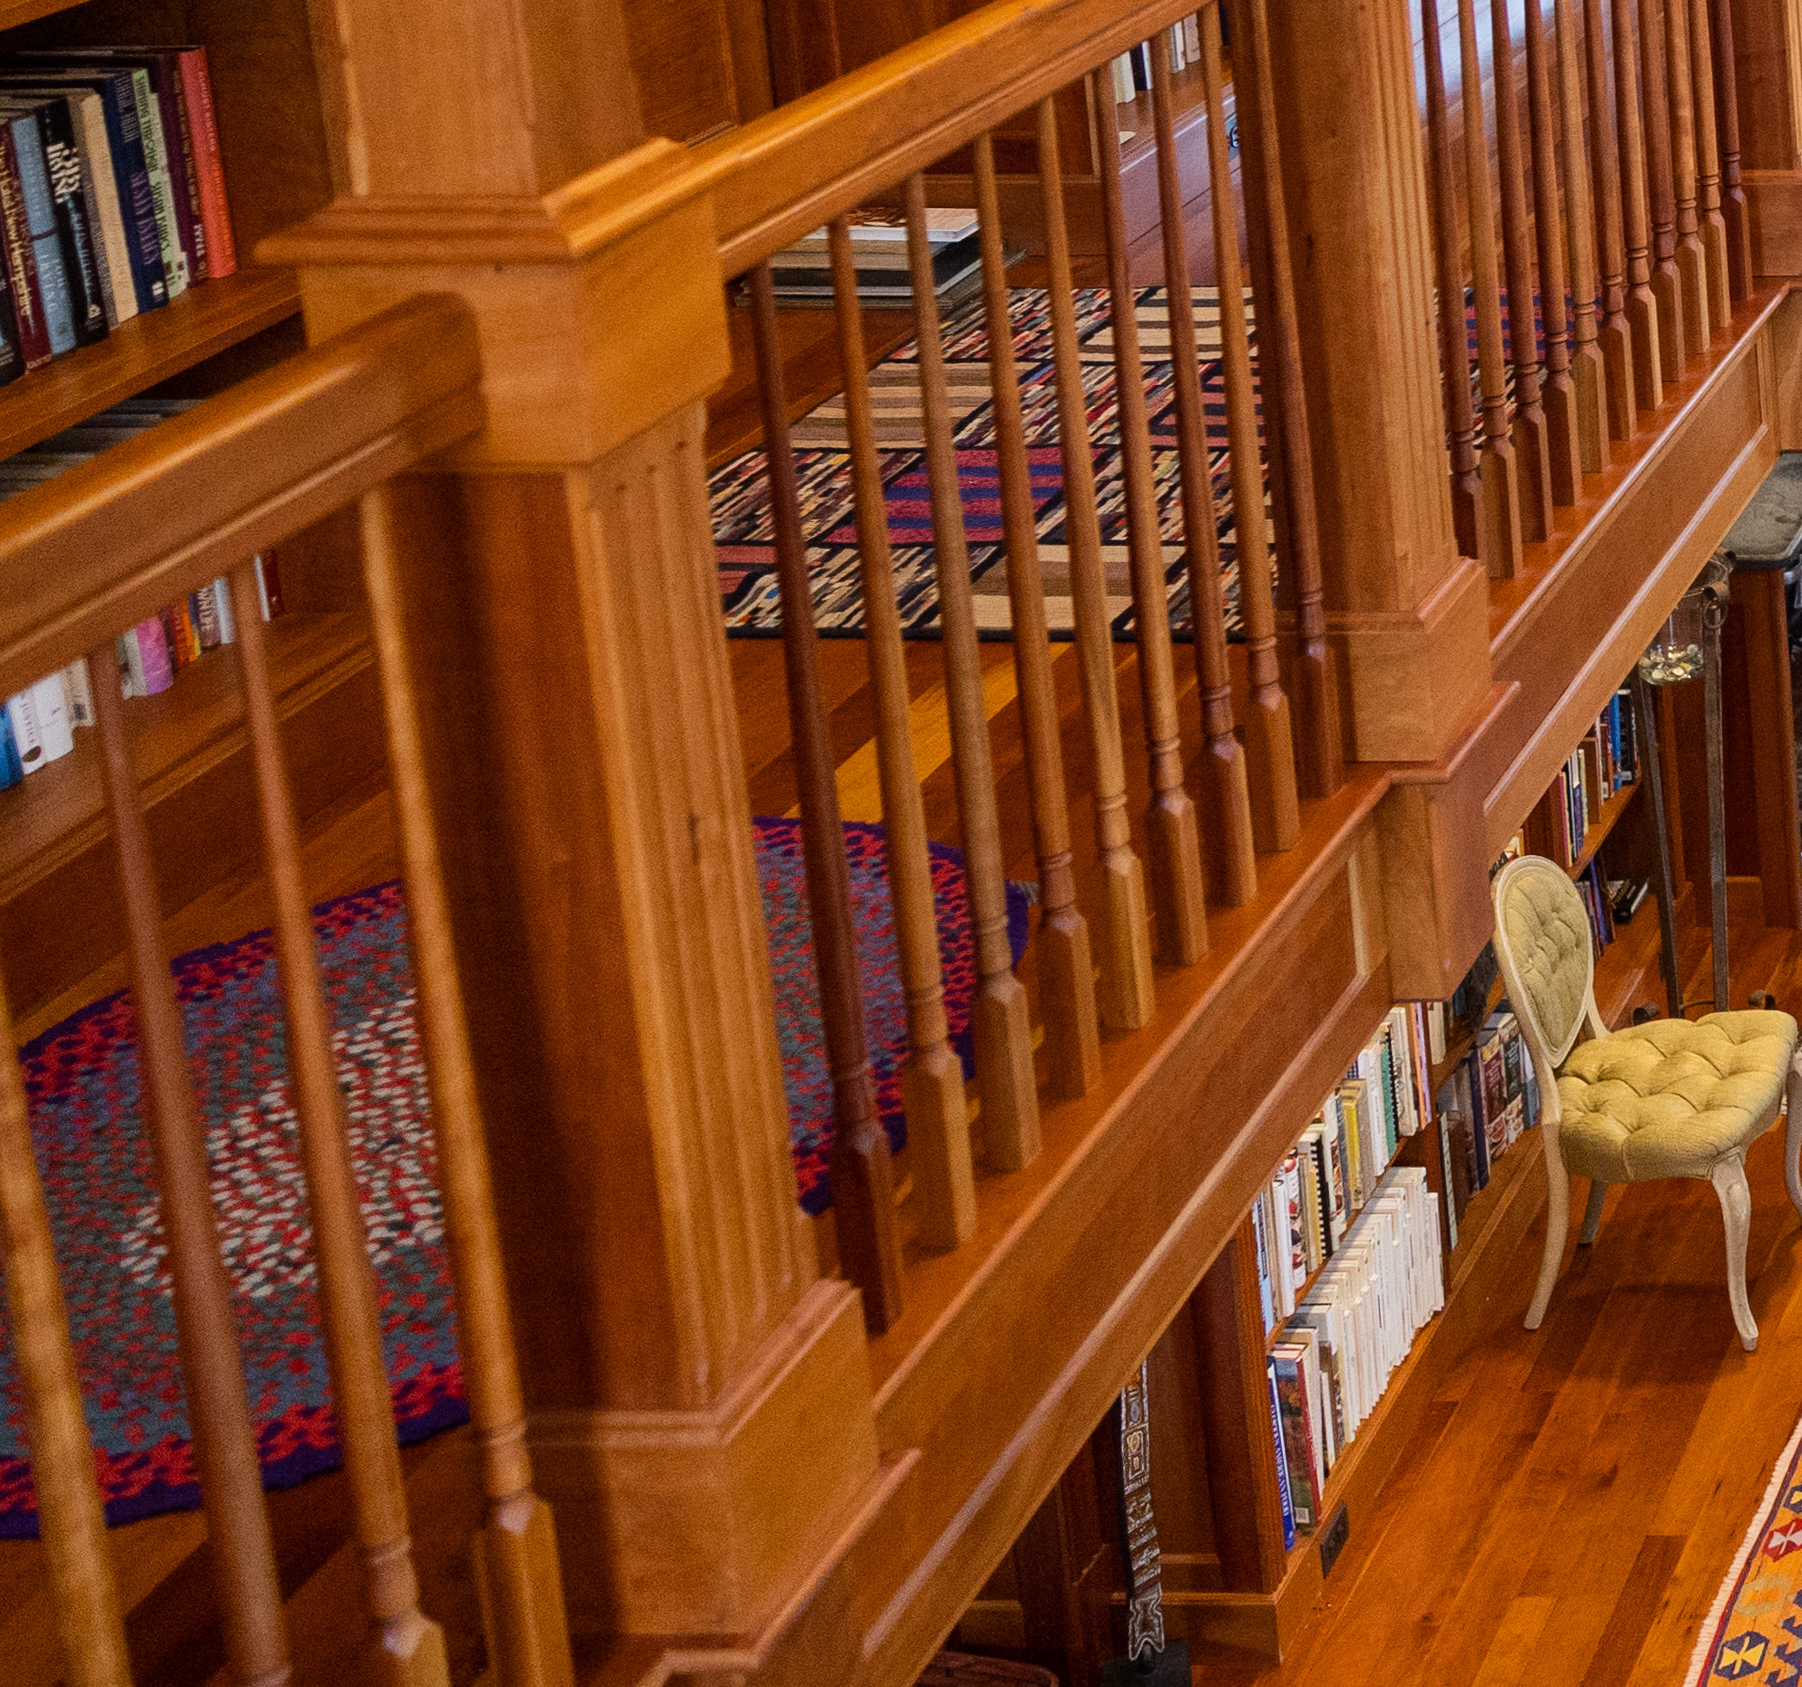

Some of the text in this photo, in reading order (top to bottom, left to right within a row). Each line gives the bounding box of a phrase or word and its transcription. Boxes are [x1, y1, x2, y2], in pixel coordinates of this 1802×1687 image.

[135, 76, 152, 118] SHINING
[7, 206, 23, 233] New
[10, 235, 36, 317] Hampshire
[39, 253, 59, 313] IRVING
[1275, 1446, 1286, 1492] AMERICAN
[1281, 1491, 1290, 1517] FOOD
